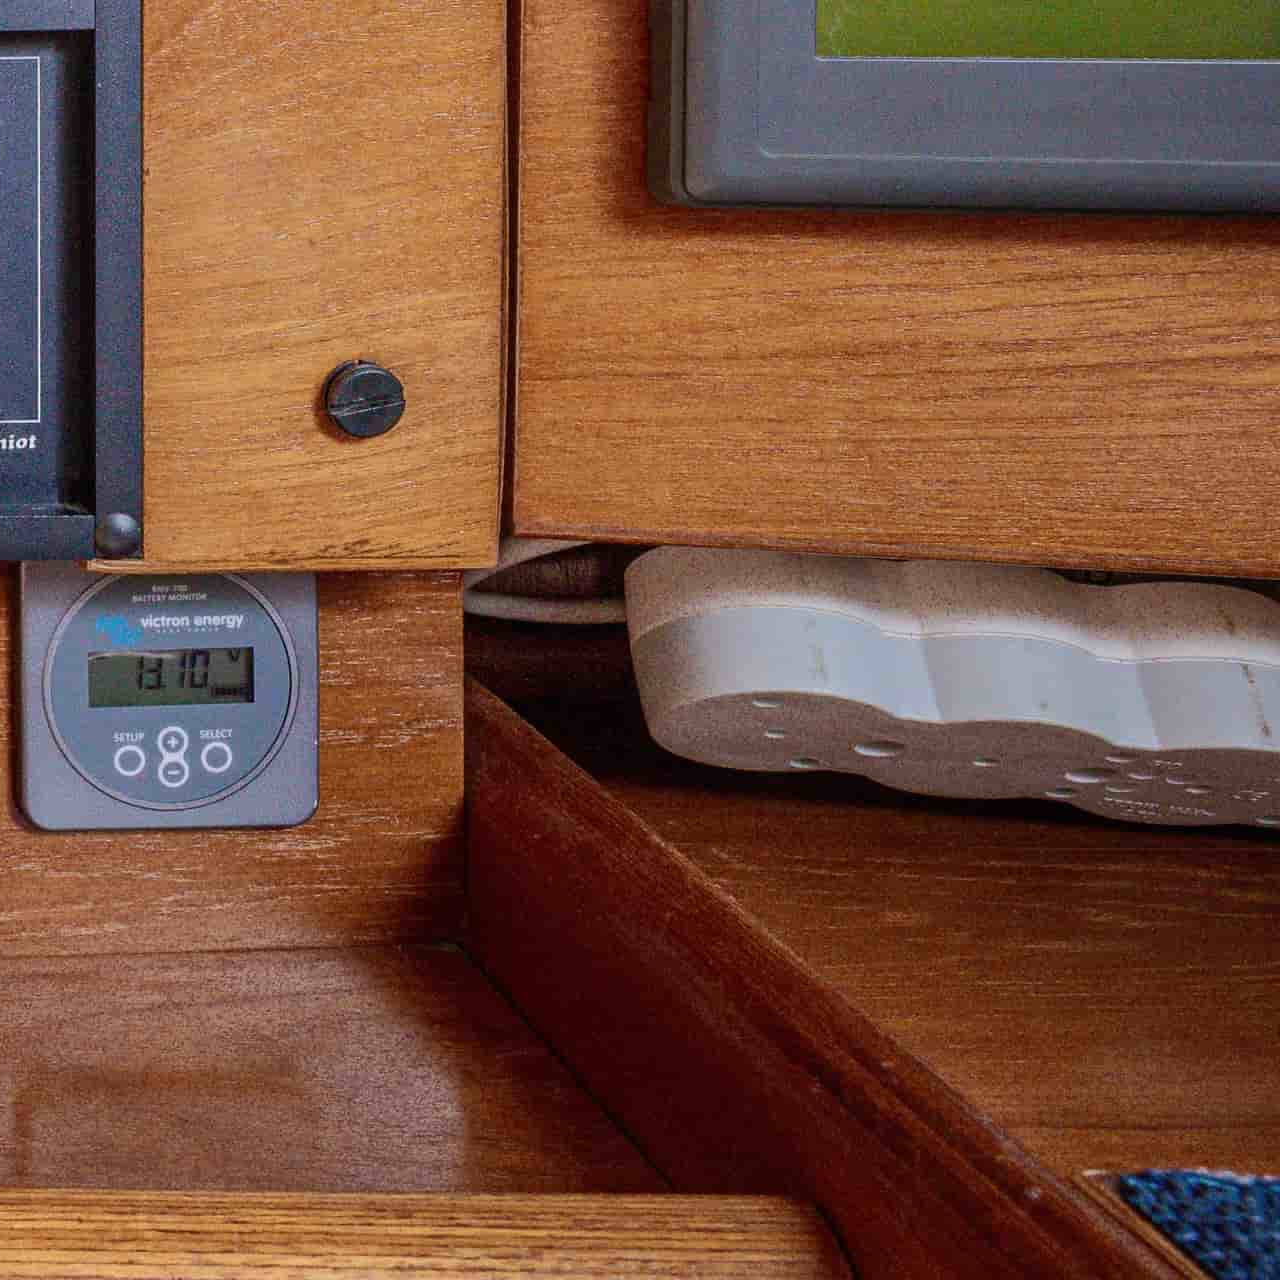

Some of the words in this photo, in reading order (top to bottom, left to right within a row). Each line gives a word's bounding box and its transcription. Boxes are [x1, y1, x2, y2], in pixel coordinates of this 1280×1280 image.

[141, 616, 189, 627] victron
[194, 615, 243, 629] energy
[112, 732, 144, 743] SETUP
[200, 729, 232, 739] SELECT
